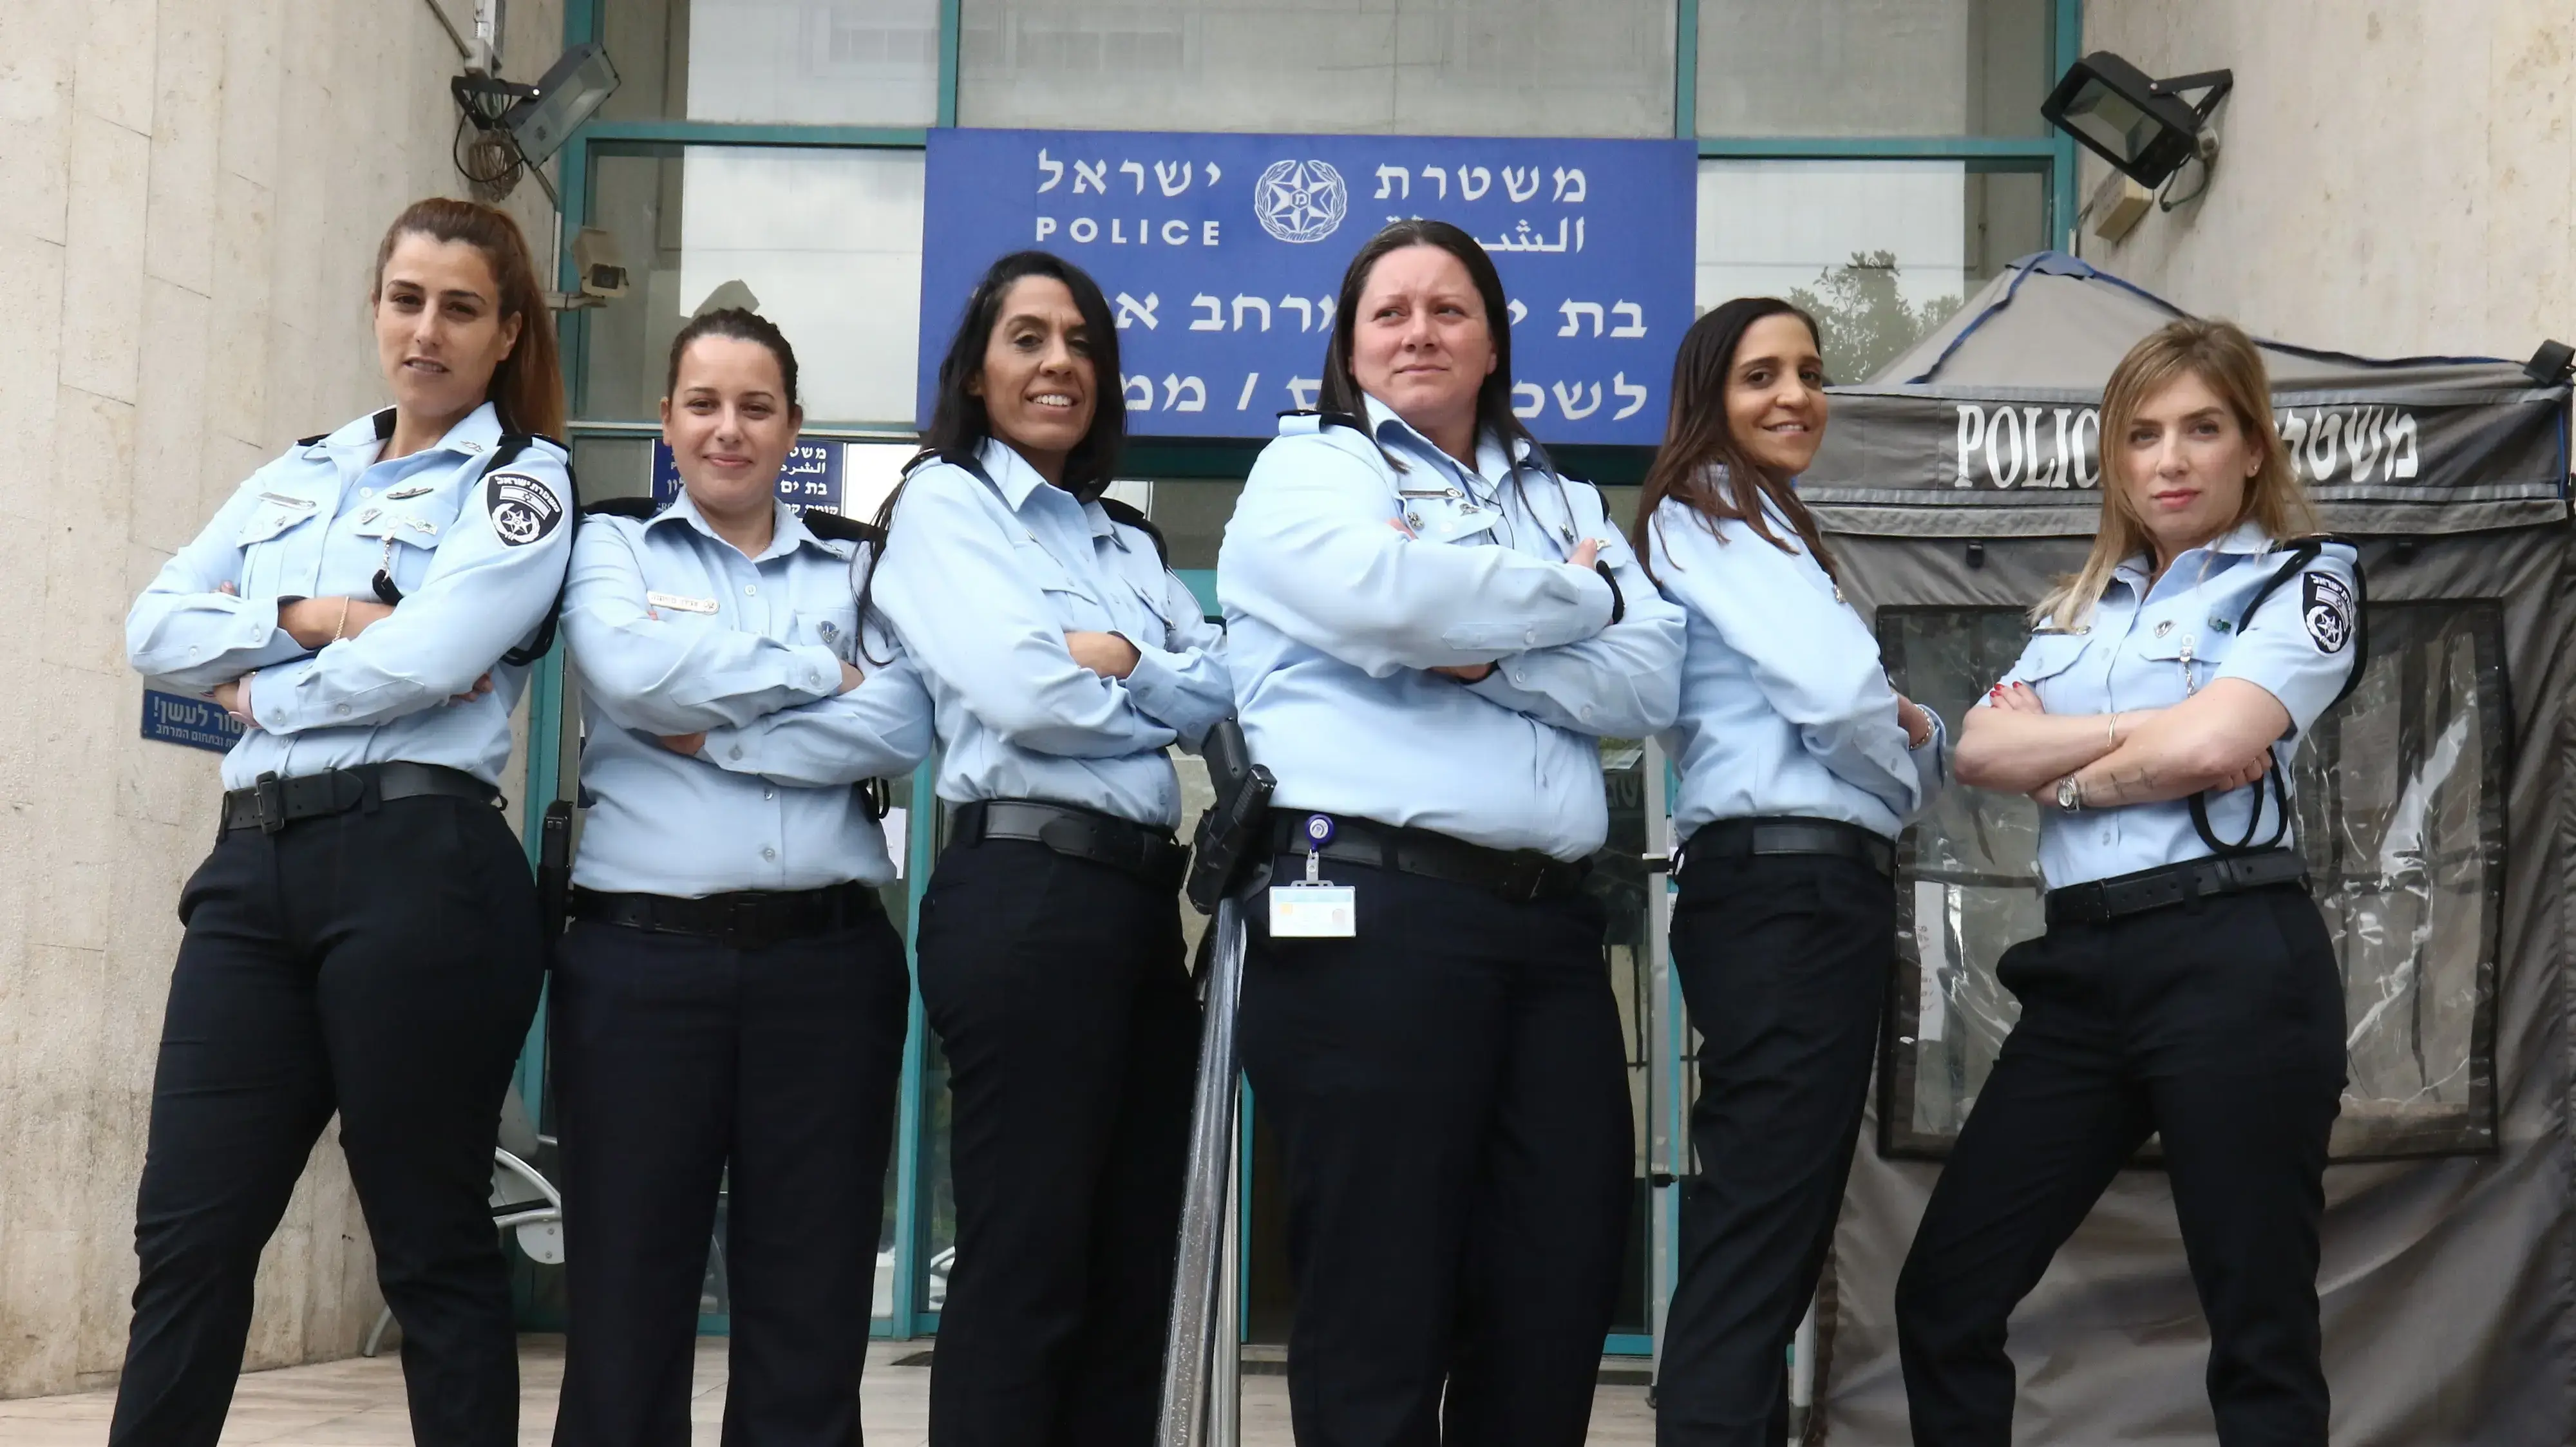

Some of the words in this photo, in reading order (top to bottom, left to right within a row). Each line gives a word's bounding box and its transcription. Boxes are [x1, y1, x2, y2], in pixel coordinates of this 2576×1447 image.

[1037, 147, 1221, 197] ישראל
[1374, 163, 1586, 203] משטרת
[1036, 216, 1220, 246] POLICE
[1557, 298, 1647, 339] בת
[1511, 371, 1647, 421] לשכ
[1955, 404, 2100, 488] POLIC
[2274, 405, 2419, 482] משטר
[494, 476, 531, 487] ישראל
[529, 484, 561, 513] משטרת
[781, 479, 799, 493] ים
[804, 481, 828, 495] בת
[214, 711, 245, 734] סור
